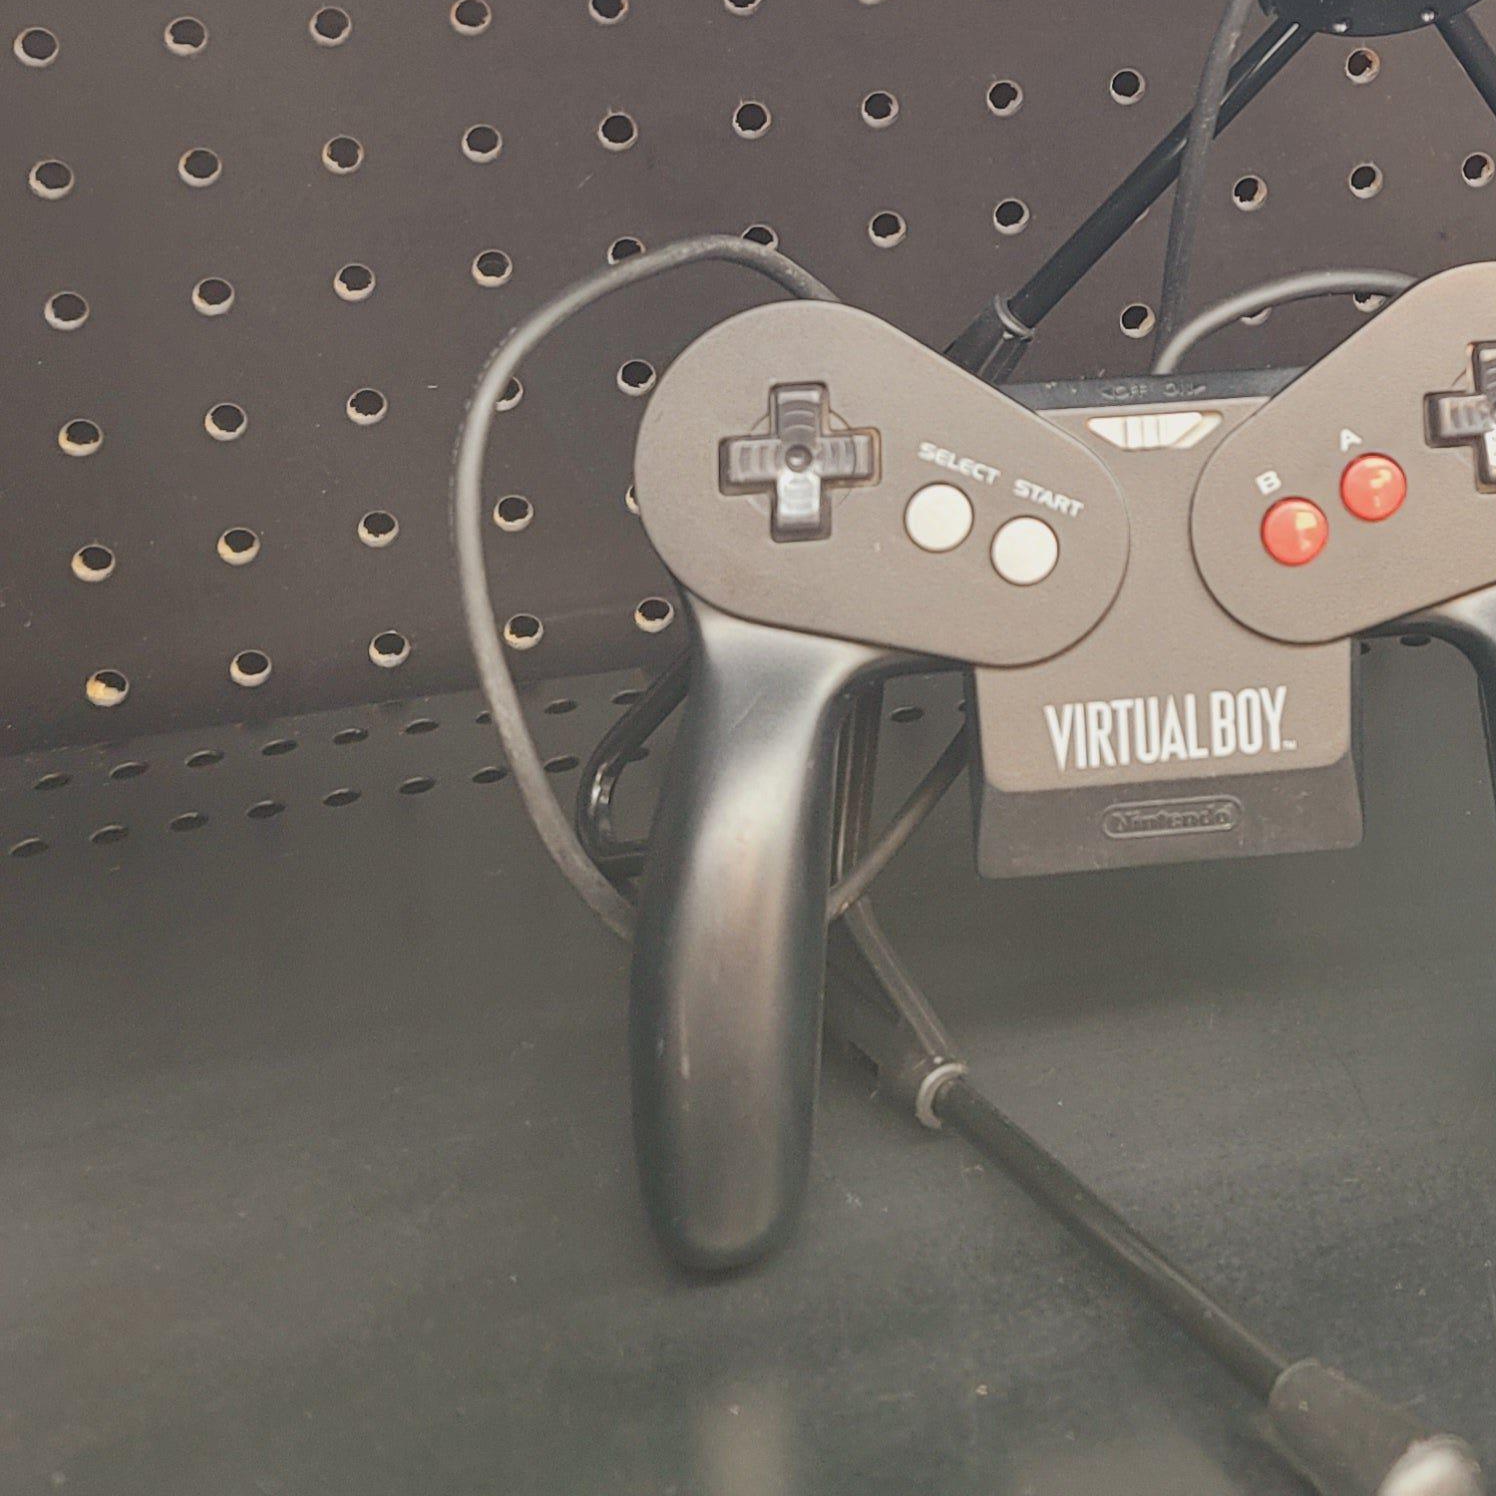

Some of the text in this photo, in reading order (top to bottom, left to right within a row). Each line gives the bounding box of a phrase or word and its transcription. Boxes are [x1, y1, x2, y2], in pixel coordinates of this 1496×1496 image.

[1339, 428, 1363, 452] A
[917, 441, 1000, 486] SELECT
[1012, 479, 1085, 518] START
[1255, 470, 1283, 495] B
[1044, 694, 1209, 772] VIRTUAL
[1209, 686, 1287, 758] BOY
[1110, 803, 1235, 832] Nintendo
